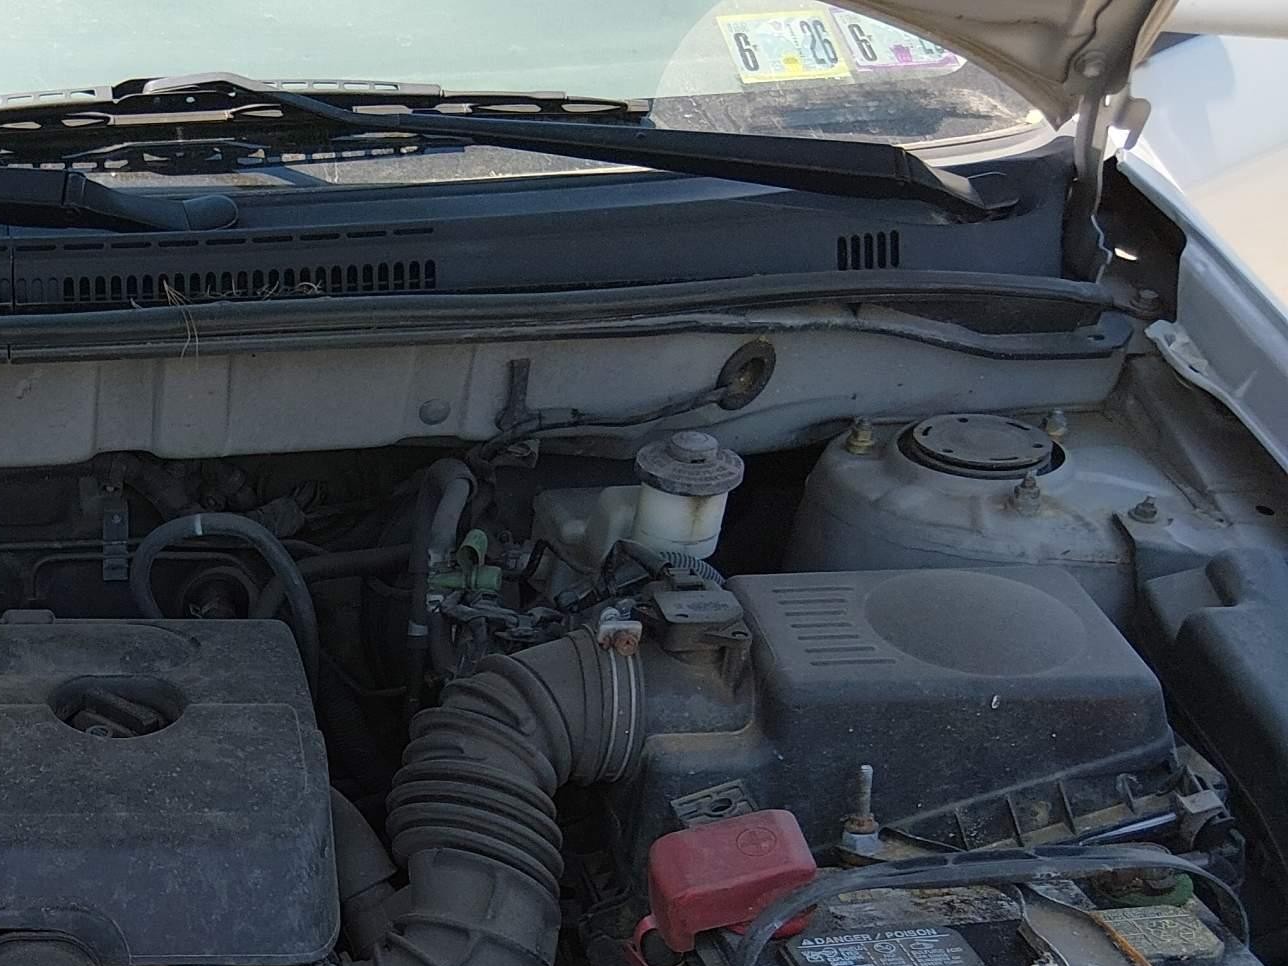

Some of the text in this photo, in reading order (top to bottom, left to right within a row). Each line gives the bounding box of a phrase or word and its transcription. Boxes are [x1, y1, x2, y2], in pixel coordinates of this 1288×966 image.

[733, 32, 759, 72] 6
[799, 19, 839, 65] 26
[848, 23, 878, 61] 6
[814, 934, 872, 945] DANGER
[885, 928, 938, 938] POISON
